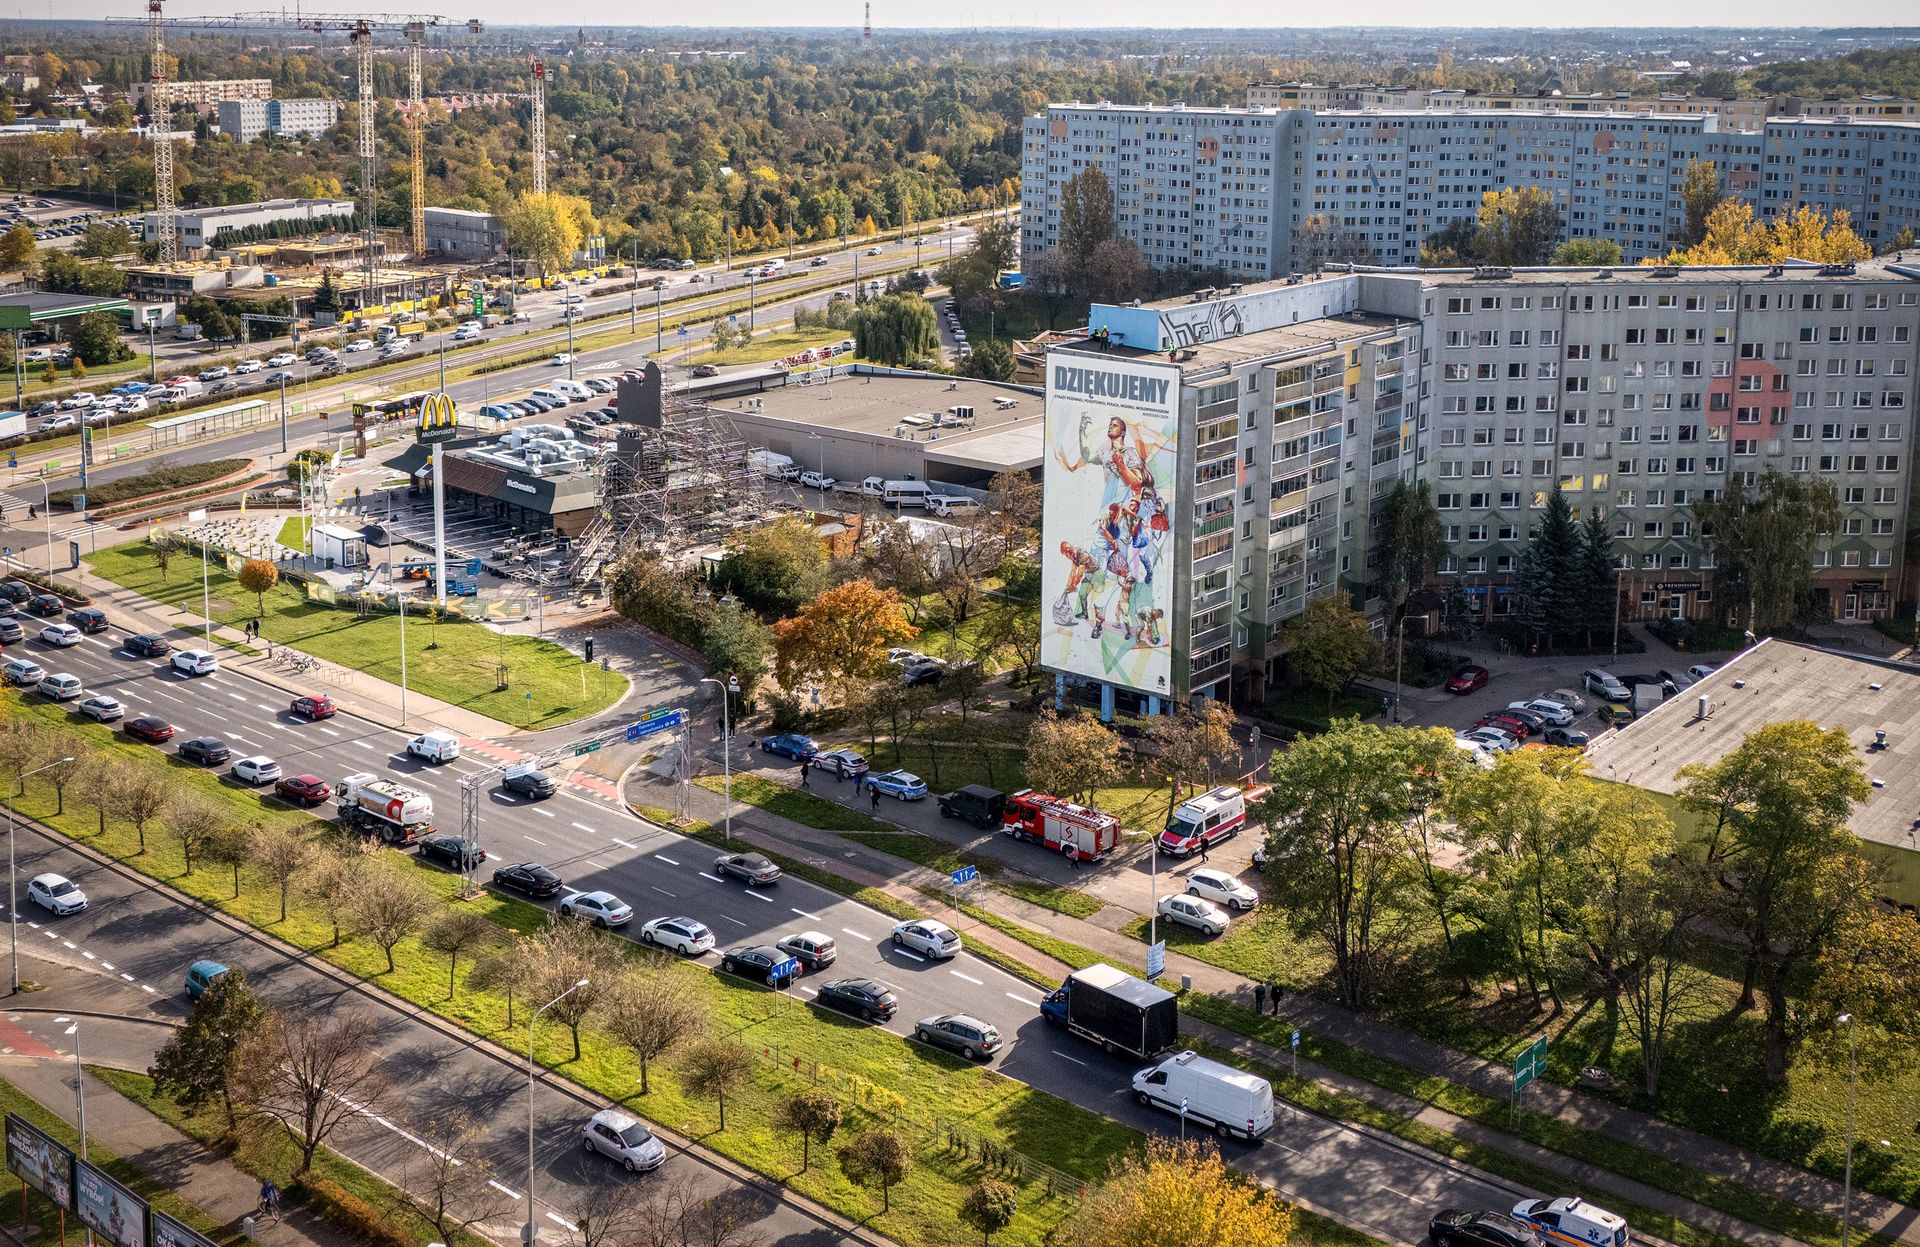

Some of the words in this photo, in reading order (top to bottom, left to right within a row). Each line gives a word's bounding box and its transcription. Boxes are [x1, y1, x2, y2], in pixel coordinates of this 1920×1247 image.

[1054, 365, 1170, 404] DZIĘKUJEMY
[421, 427, 456, 438] McDonald's
[506, 479, 537, 494] McDonald's
